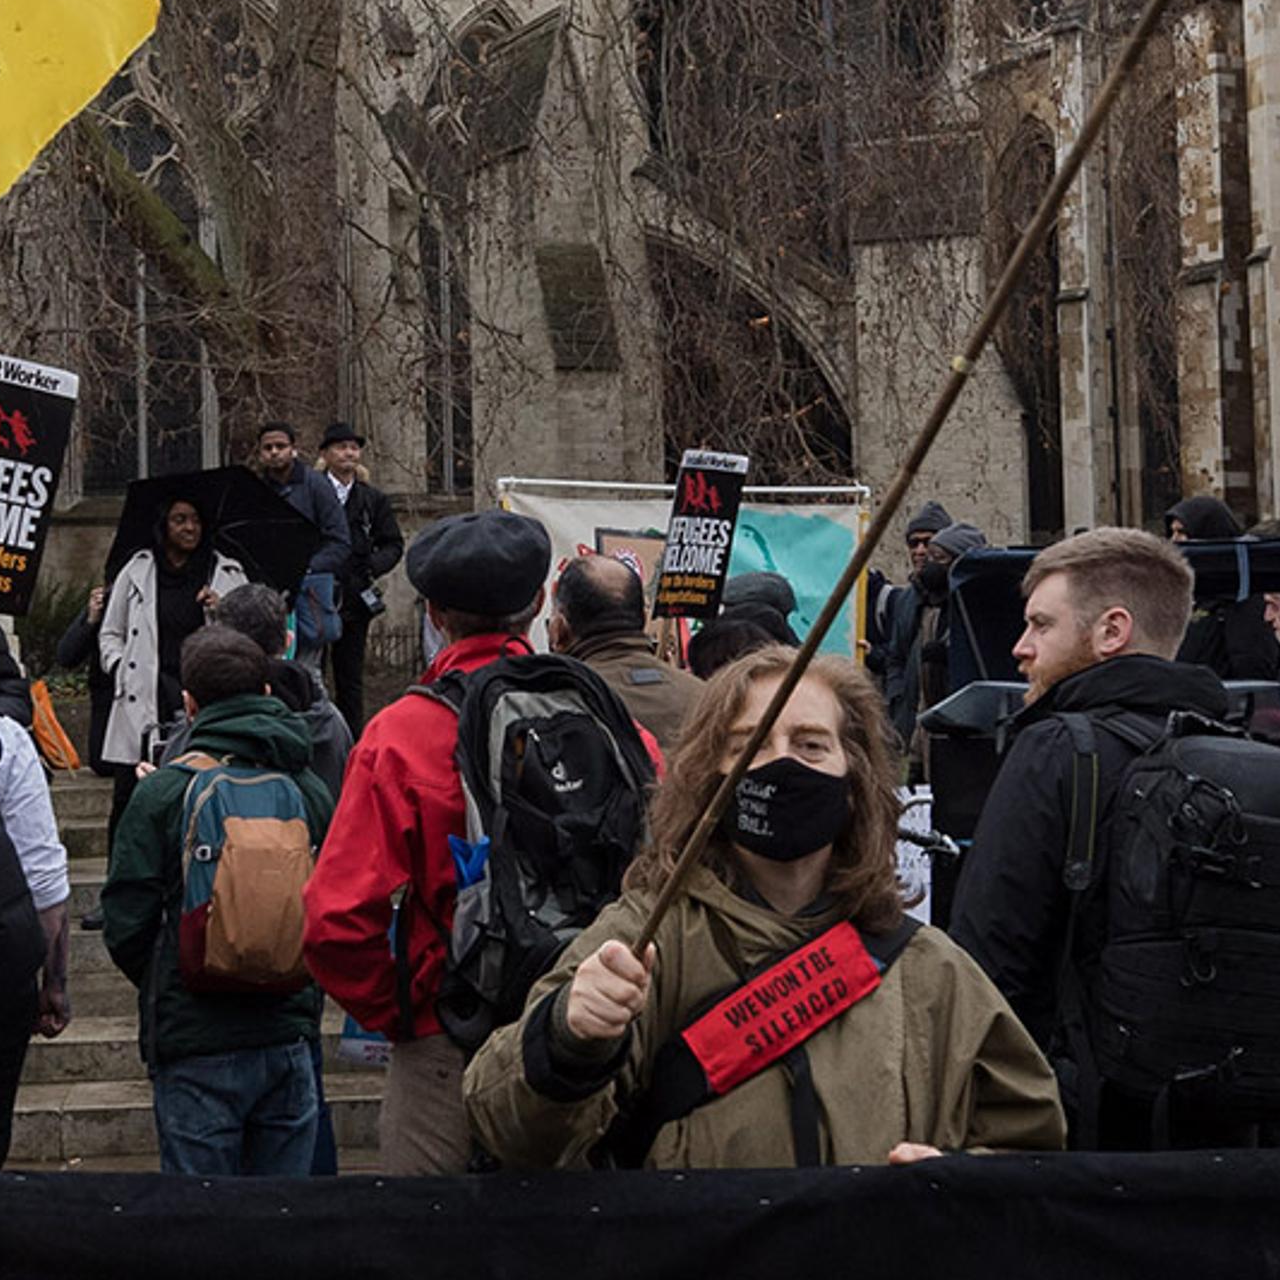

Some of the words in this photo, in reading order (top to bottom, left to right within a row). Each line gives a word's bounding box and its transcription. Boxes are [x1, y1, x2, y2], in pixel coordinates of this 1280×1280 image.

[3, 360, 61, 392] Worker
[724, 995, 759, 1029] WE
[807, 946, 837, 974] BE
[744, 977, 848, 1056] SILENCED
